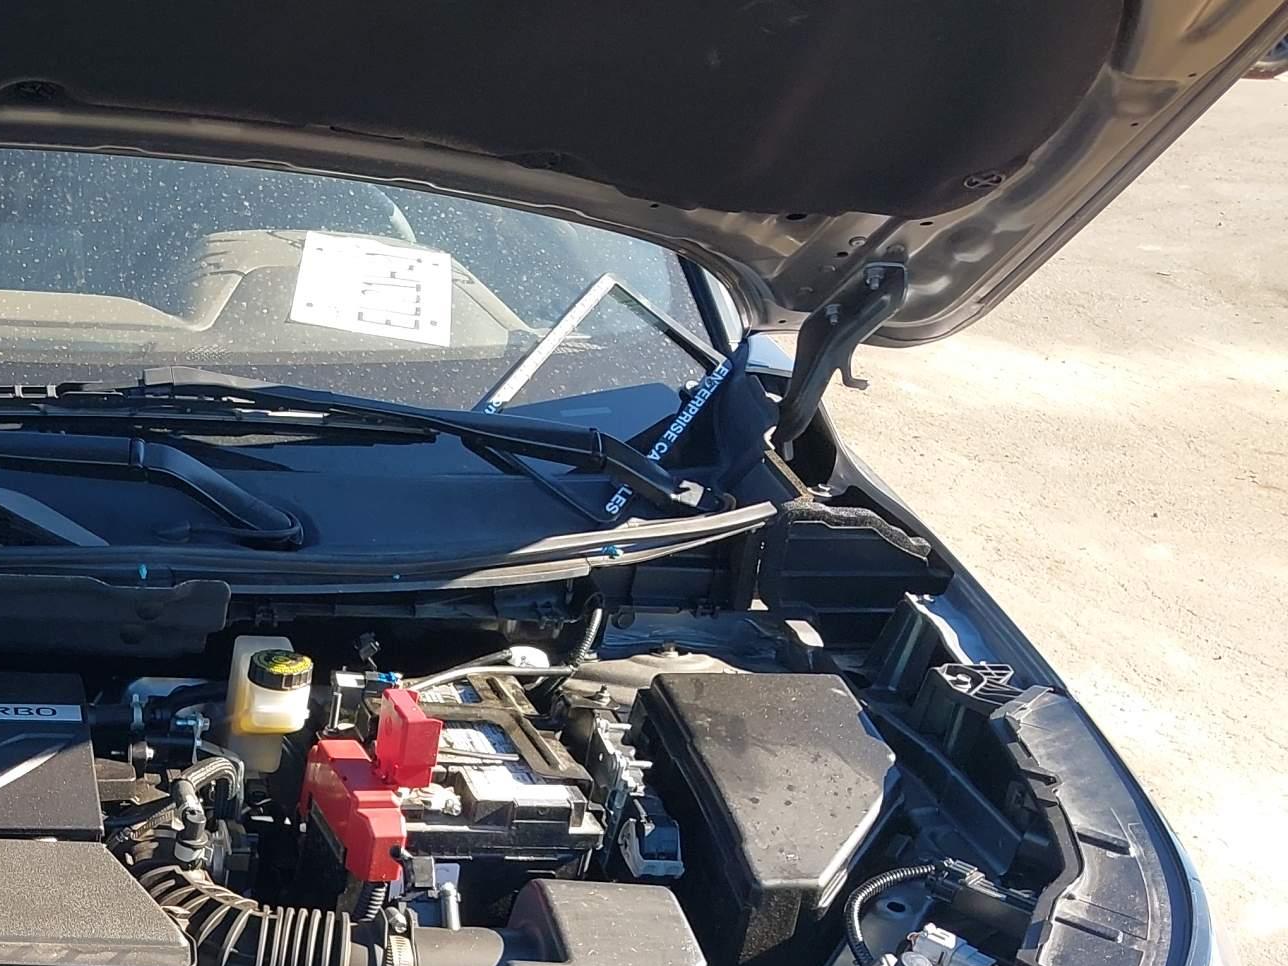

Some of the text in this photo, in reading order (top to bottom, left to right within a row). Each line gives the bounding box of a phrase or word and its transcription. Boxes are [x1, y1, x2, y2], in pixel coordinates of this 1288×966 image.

[605, 364, 729, 515] ENTERPRISE CA LES
